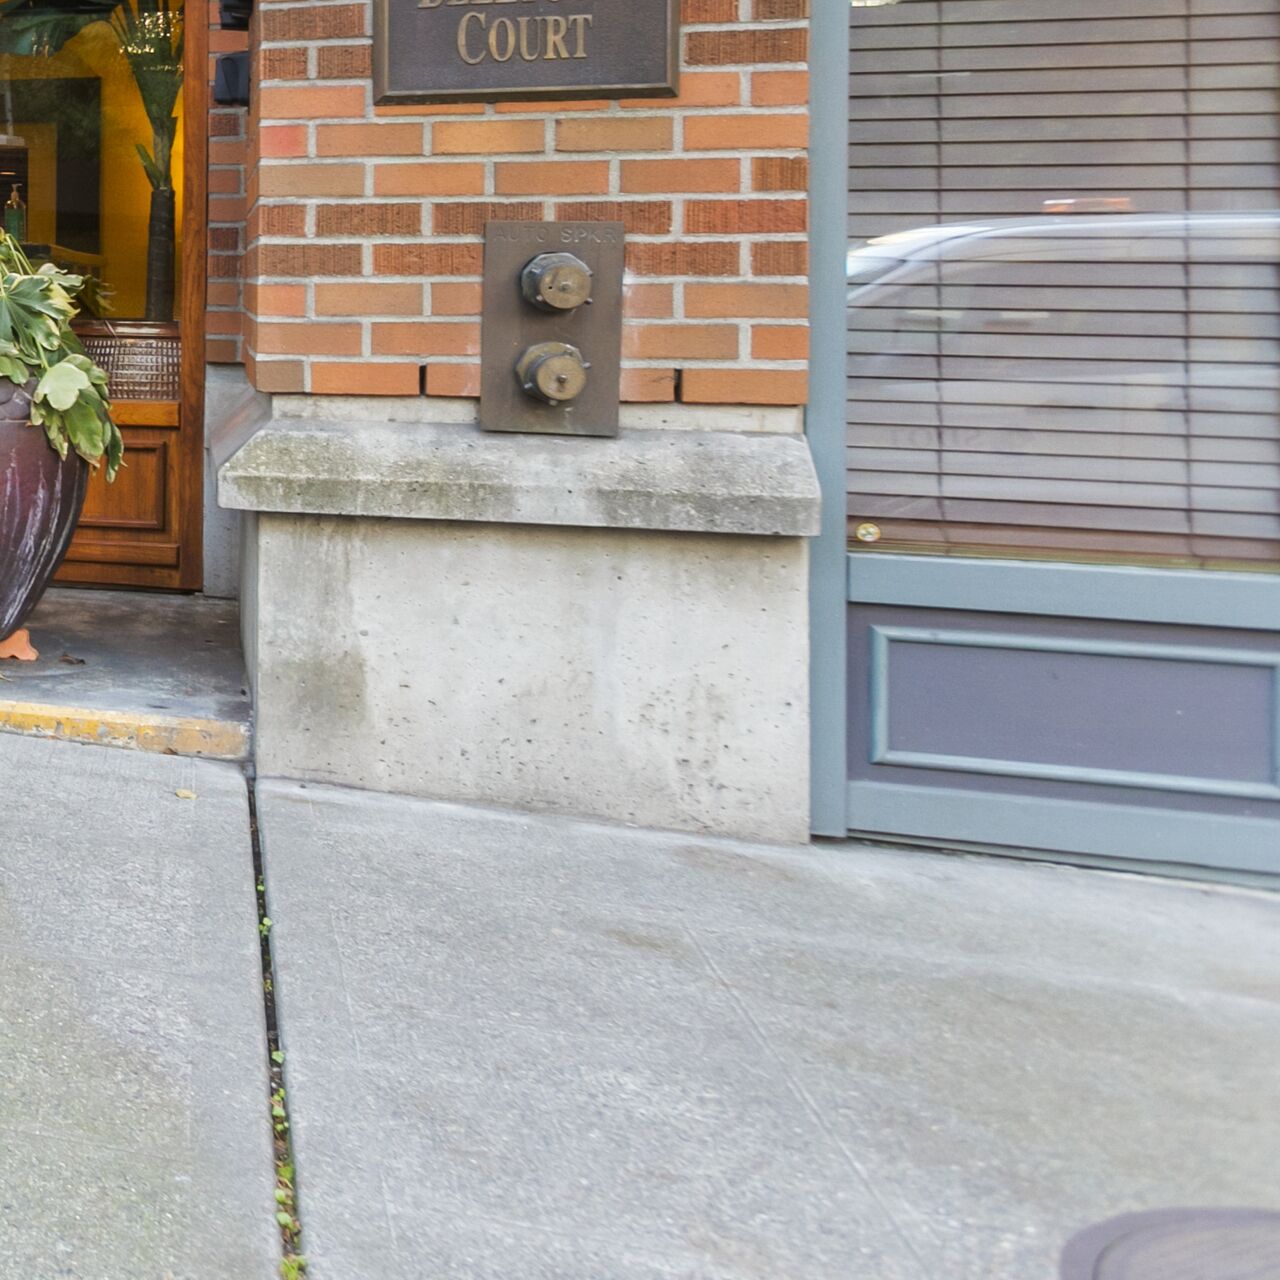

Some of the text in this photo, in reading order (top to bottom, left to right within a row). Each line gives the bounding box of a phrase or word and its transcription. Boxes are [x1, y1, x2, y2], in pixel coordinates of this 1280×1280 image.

[456, 11, 593, 65] COURT
[494, 226, 616, 244] AUTO SPKR
